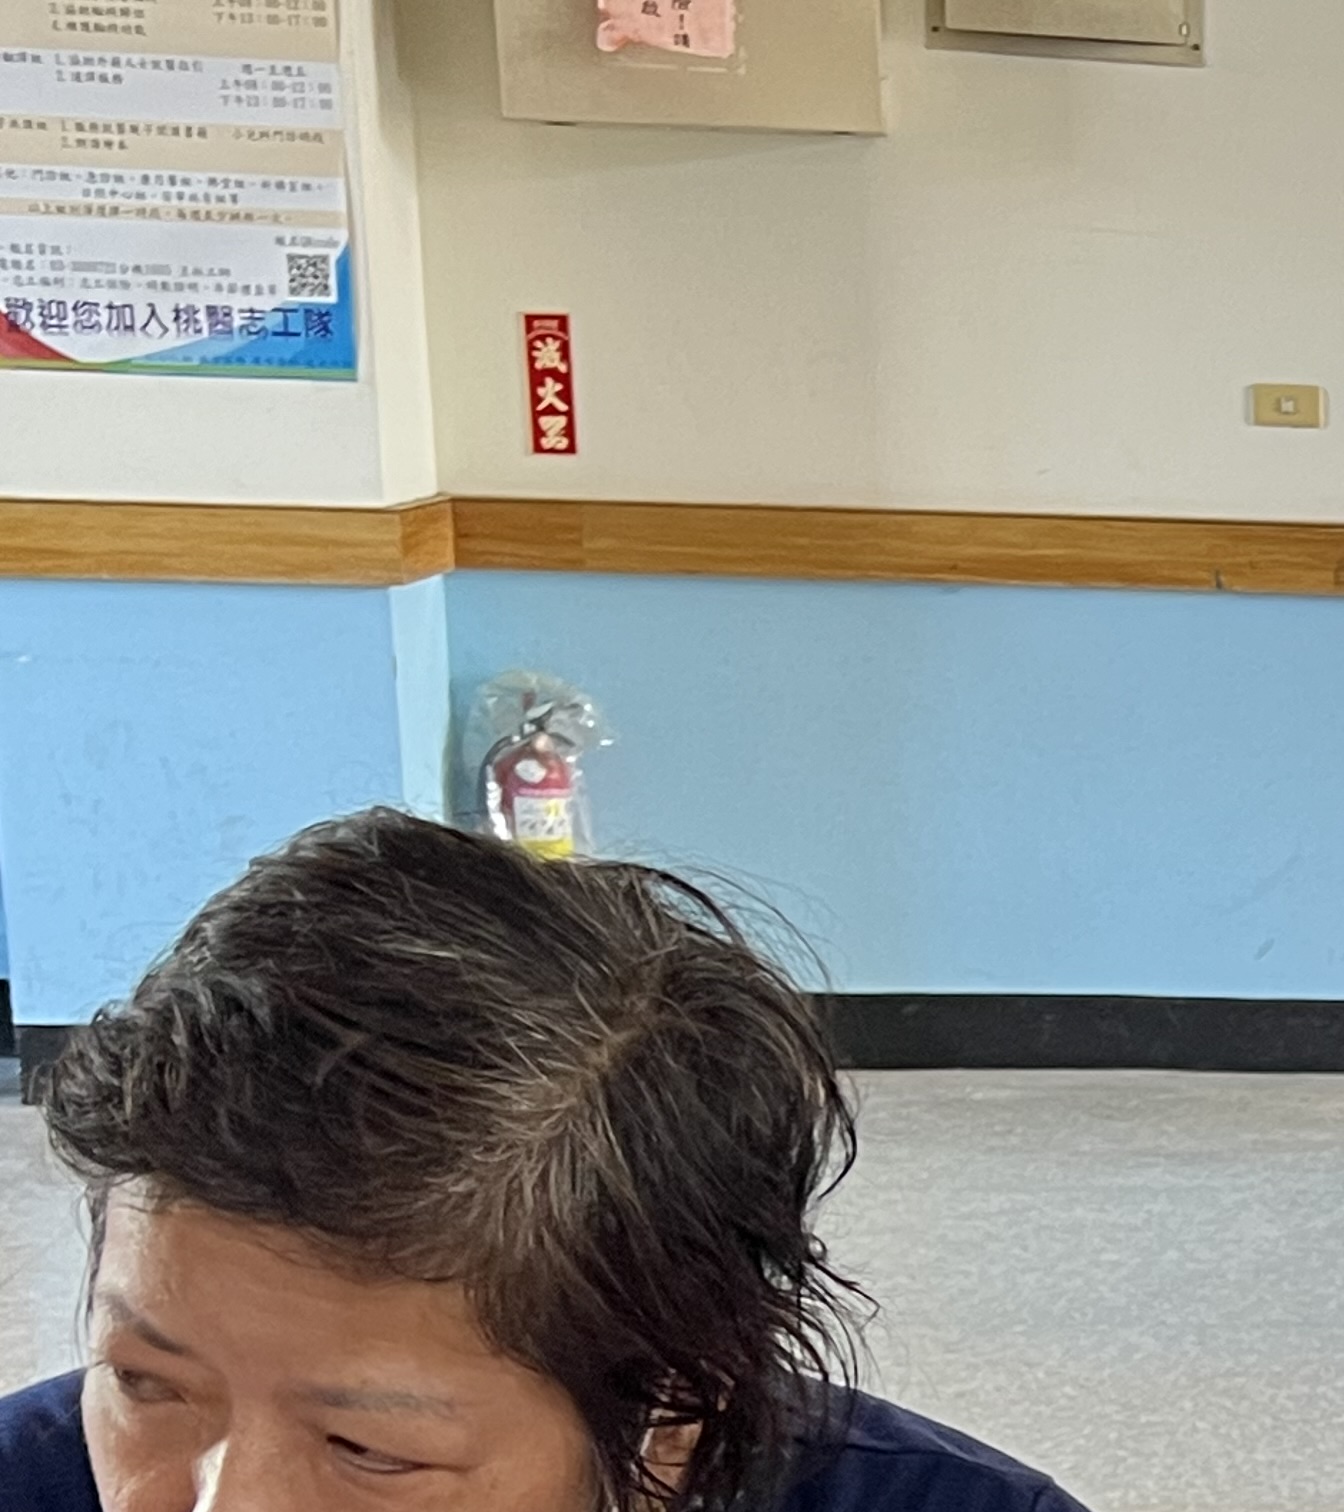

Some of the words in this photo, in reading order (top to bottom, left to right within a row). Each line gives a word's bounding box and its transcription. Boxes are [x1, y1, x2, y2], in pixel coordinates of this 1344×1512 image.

[7, 298, 334, 338] 歡迎您加入桃醫志工隊
[531, 336, 569, 450] 滅火器
